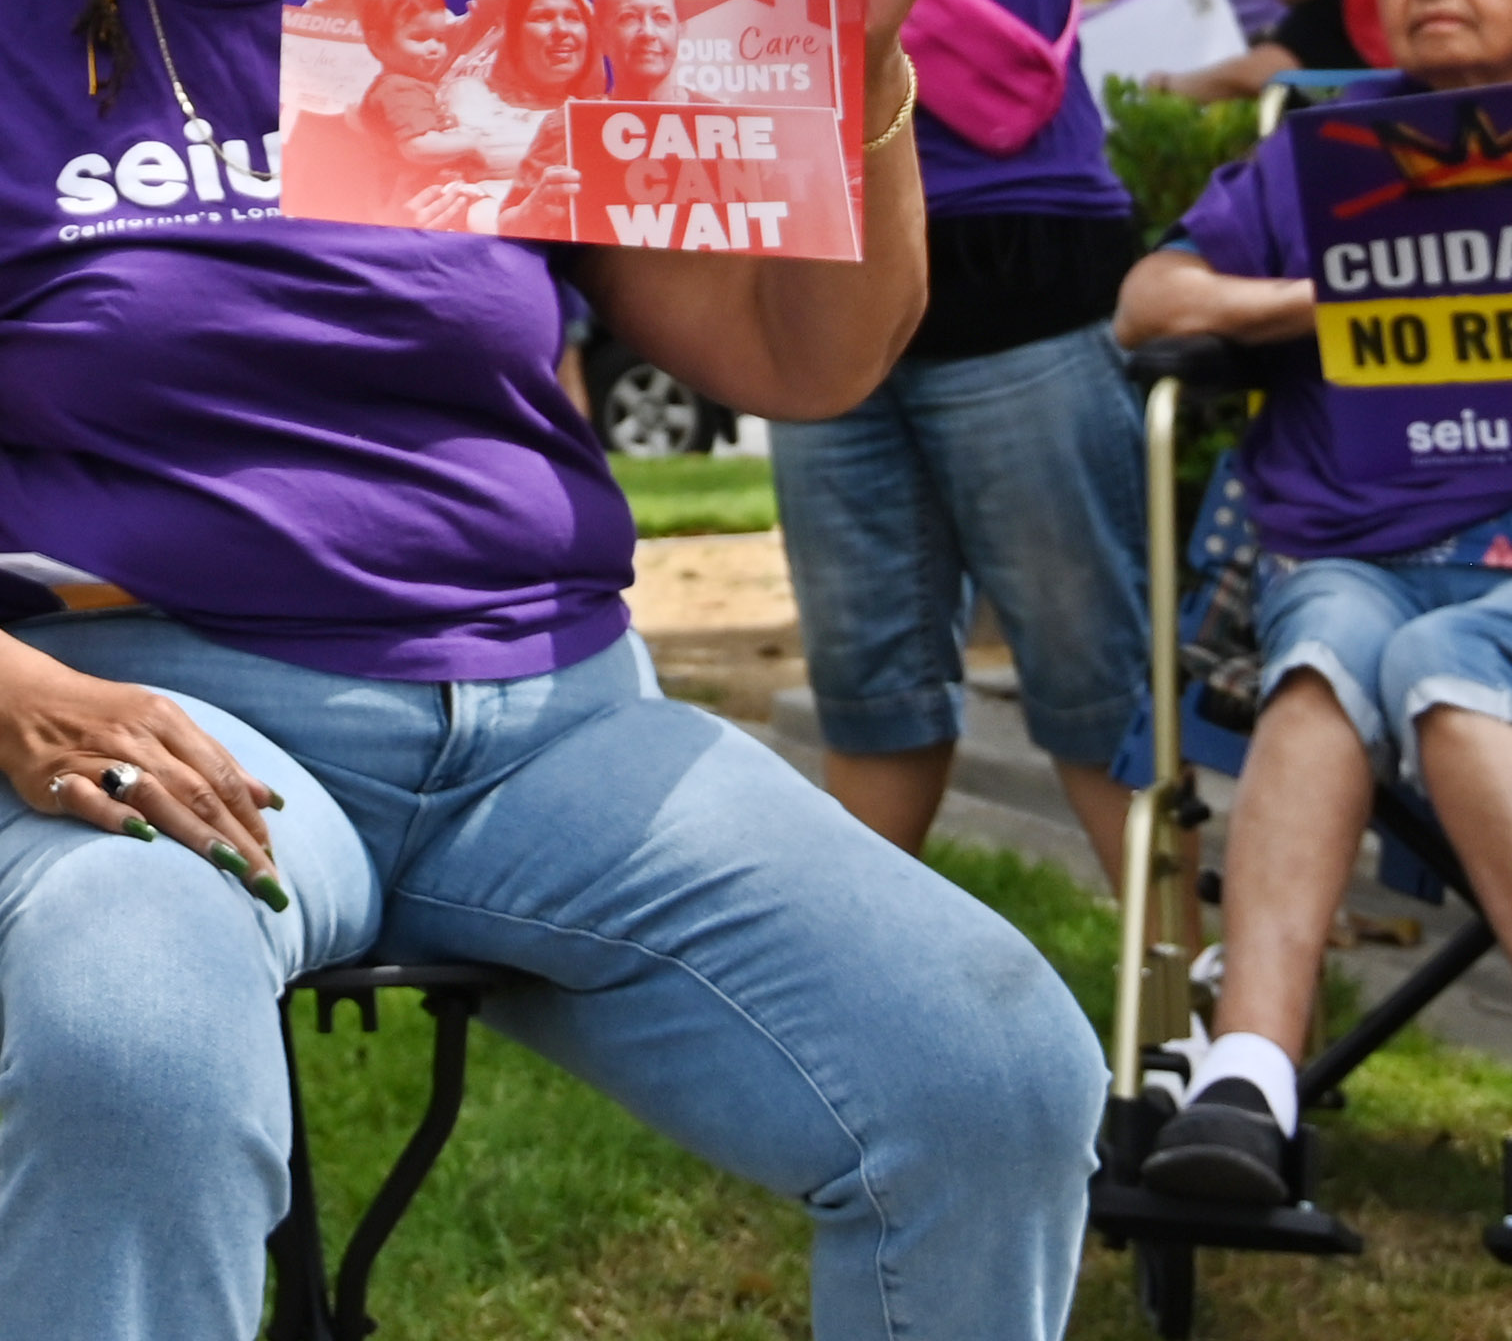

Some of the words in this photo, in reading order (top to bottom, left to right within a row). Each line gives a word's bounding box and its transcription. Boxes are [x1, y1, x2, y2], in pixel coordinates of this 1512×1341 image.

[282, 10, 364, 37] MEDICA
[677, 37, 733, 62] OUR
[739, 25, 821, 61] Care
[677, 62, 811, 93] COUNTS
[601, 111, 778, 161] CARE
[55, 118, 282, 215] seiu
[58, 211, 223, 243] California's
[605, 201, 789, 250] WAIT
[1349, 313, 1430, 369] NO
